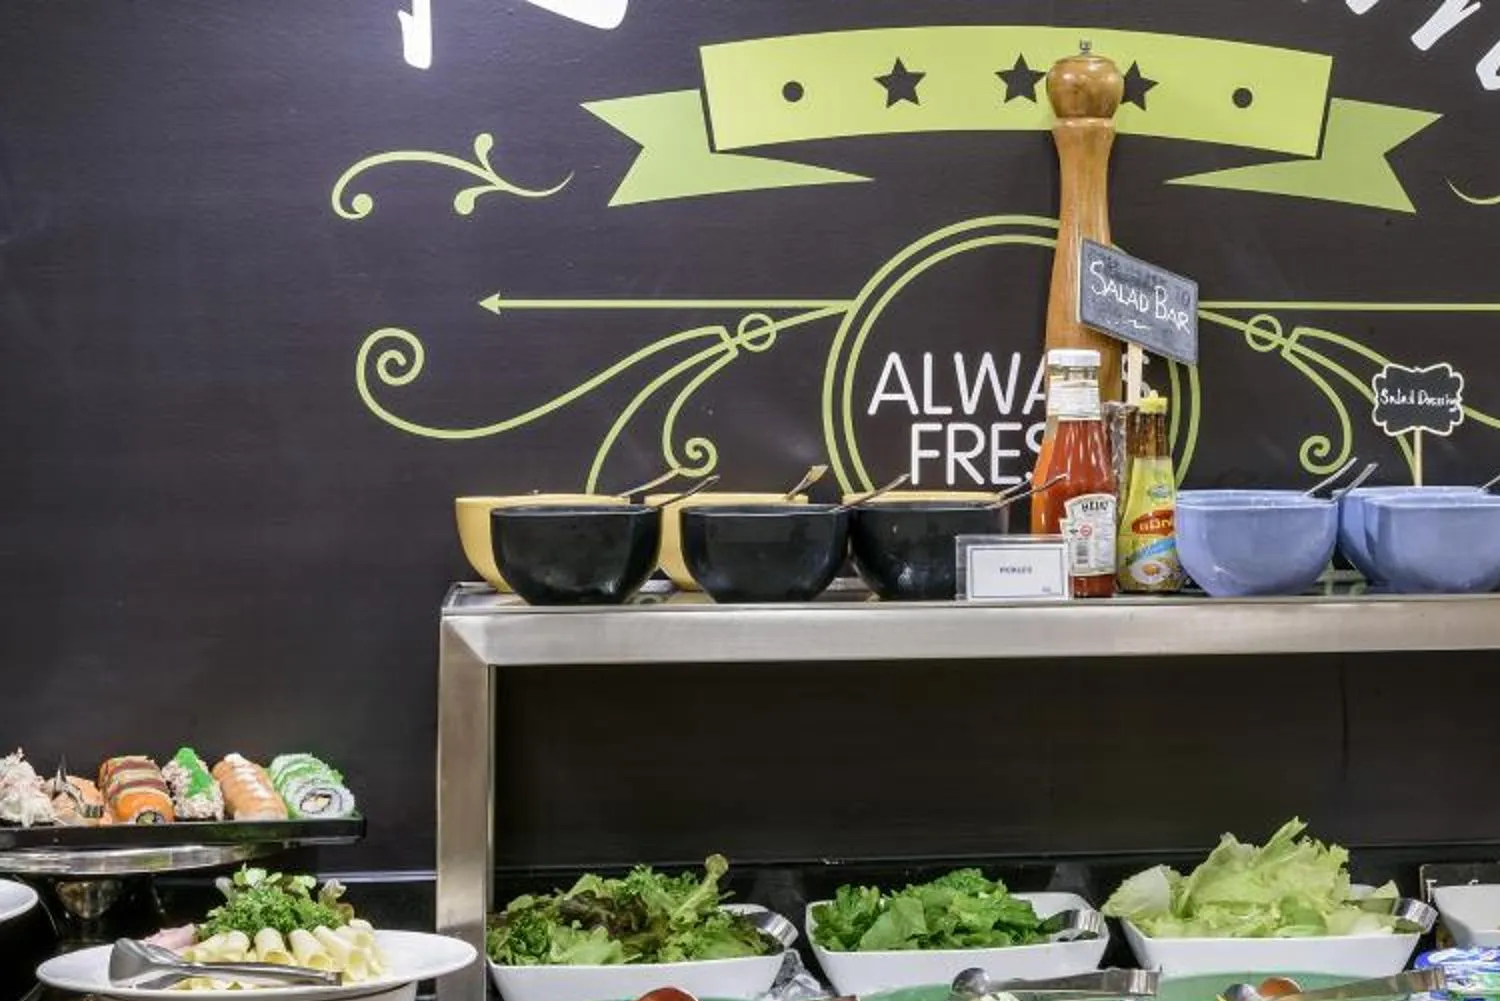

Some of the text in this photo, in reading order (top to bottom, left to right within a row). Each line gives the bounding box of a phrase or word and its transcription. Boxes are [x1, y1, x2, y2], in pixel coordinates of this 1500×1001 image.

[1089, 260, 1191, 335] SALAD BAR
[1380, 388, 1415, 404] Salad
